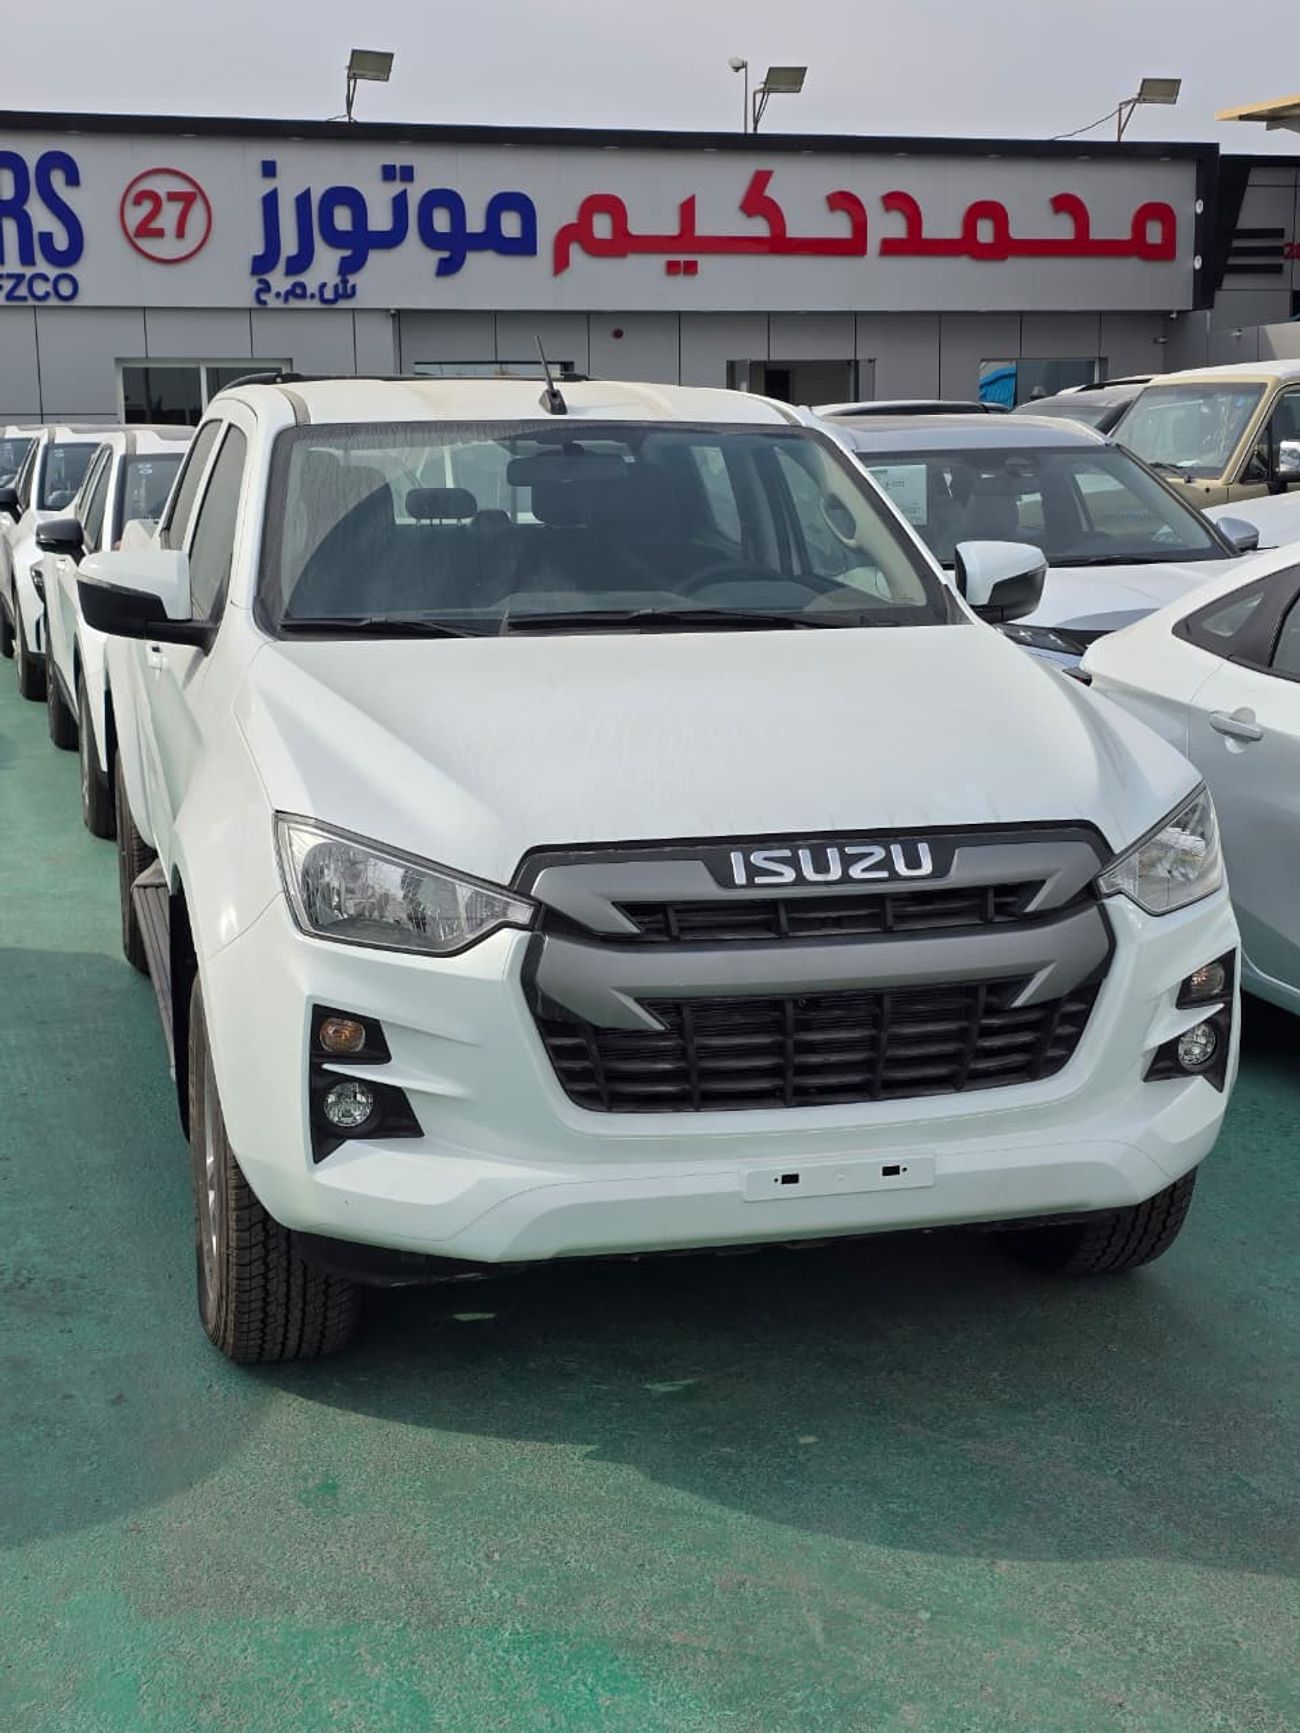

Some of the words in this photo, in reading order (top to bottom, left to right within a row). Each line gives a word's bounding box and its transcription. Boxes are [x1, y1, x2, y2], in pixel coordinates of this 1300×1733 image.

[132, 189, 197, 239] 27
[250, 160, 539, 277] موتورز
[0, 272, 79, 302] ZCO
[730, 842, 933, 885] ISUZU
